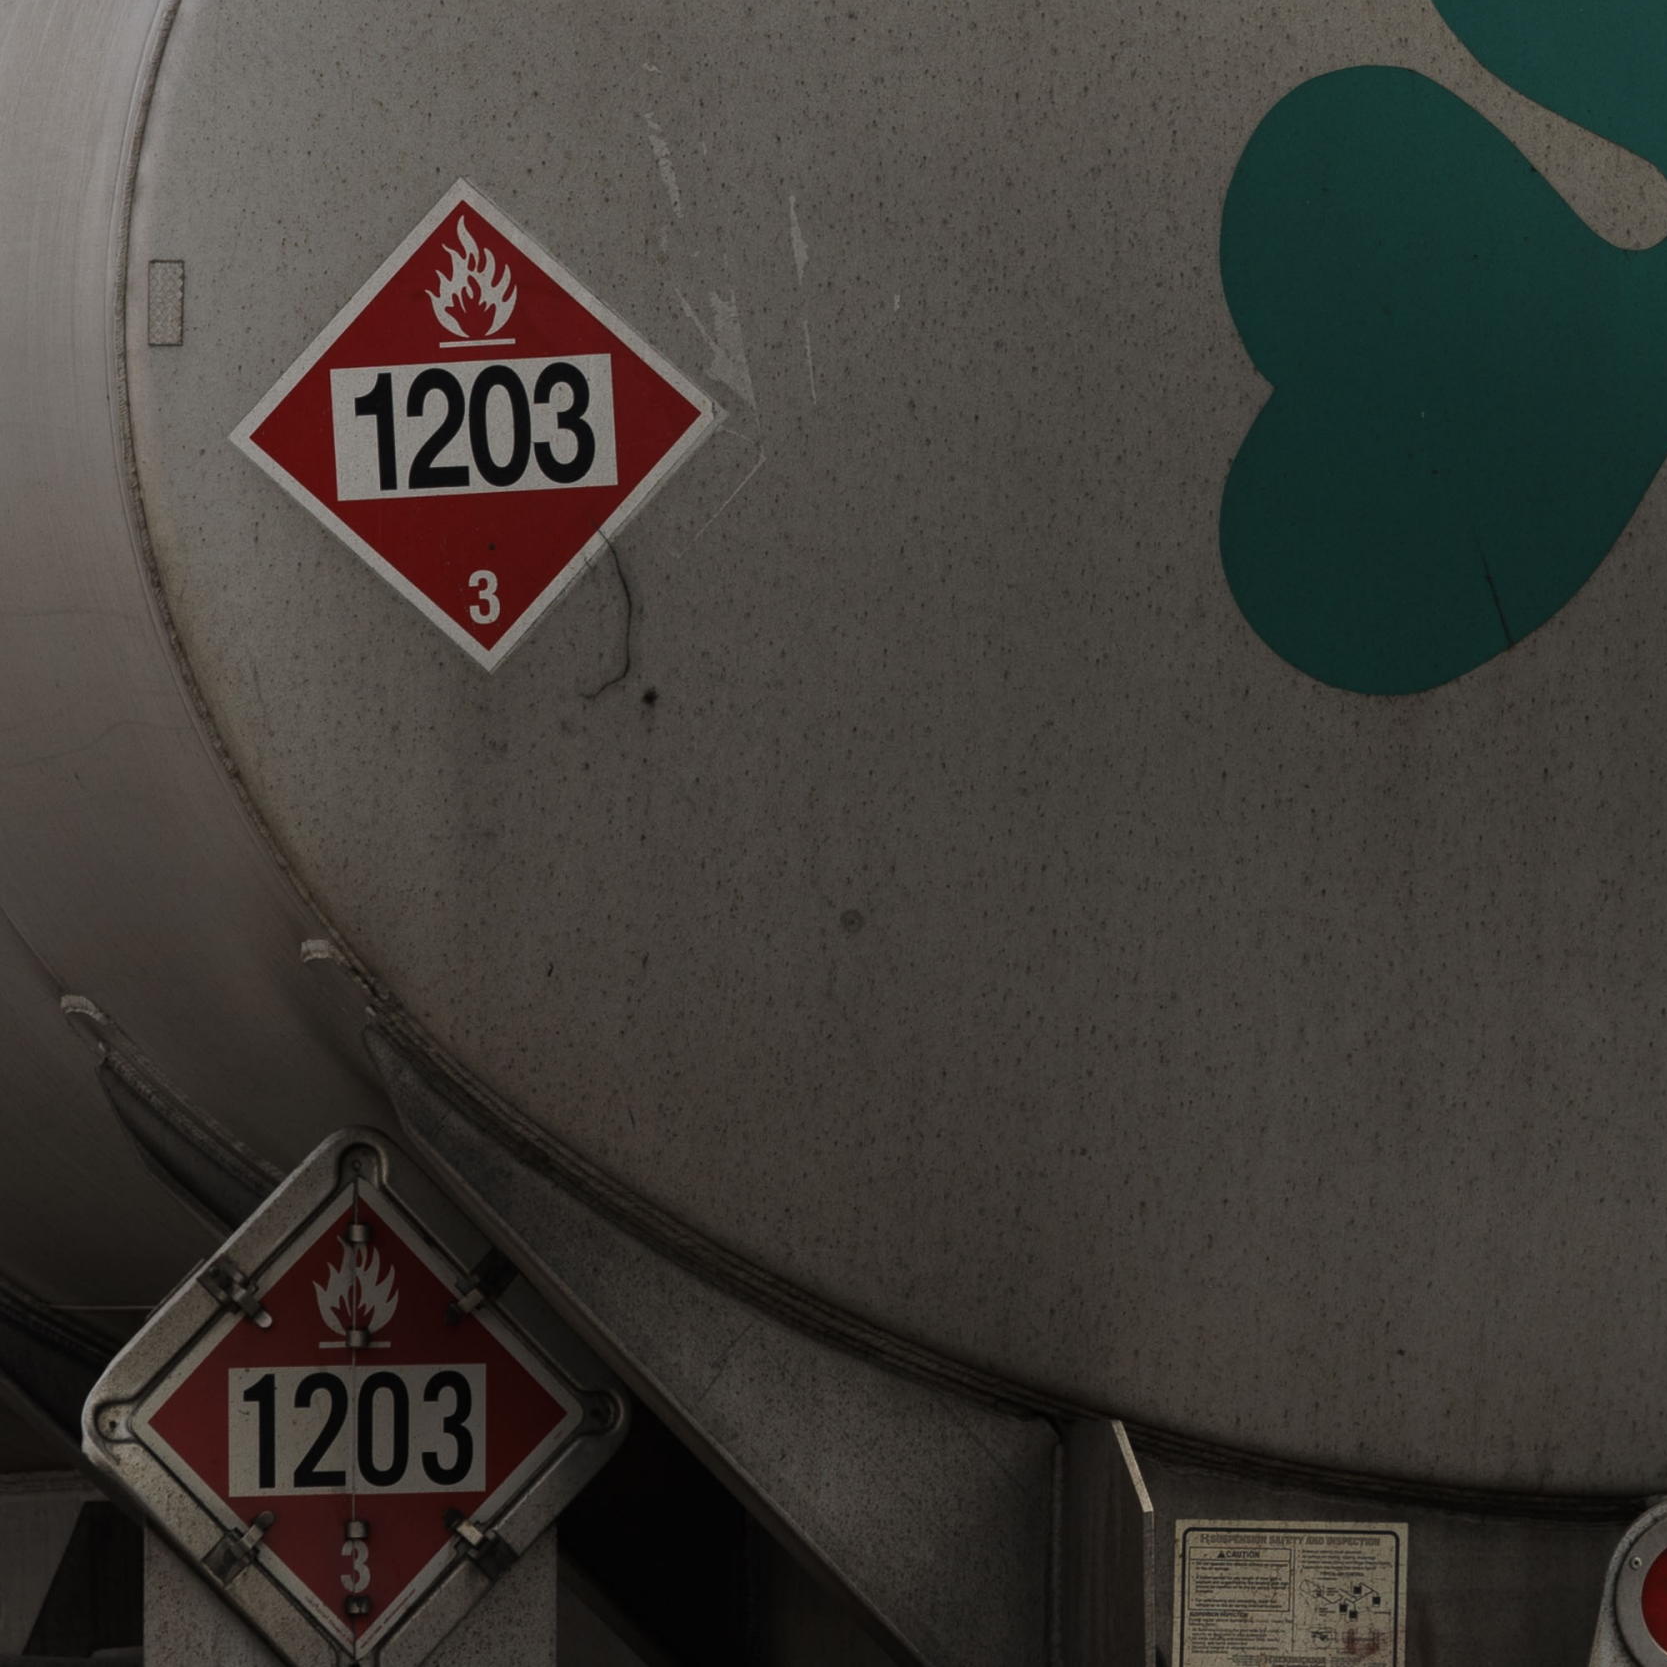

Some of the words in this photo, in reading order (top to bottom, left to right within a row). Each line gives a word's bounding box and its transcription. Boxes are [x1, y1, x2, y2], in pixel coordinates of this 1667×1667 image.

[354, 361, 596, 491] 1203
[467, 569, 501, 625] 3
[243, 1369, 474, 1489] 1203
[340, 1540, 371, 1594] 3
[1226, 1550, 1260, 1559] CAUTION
